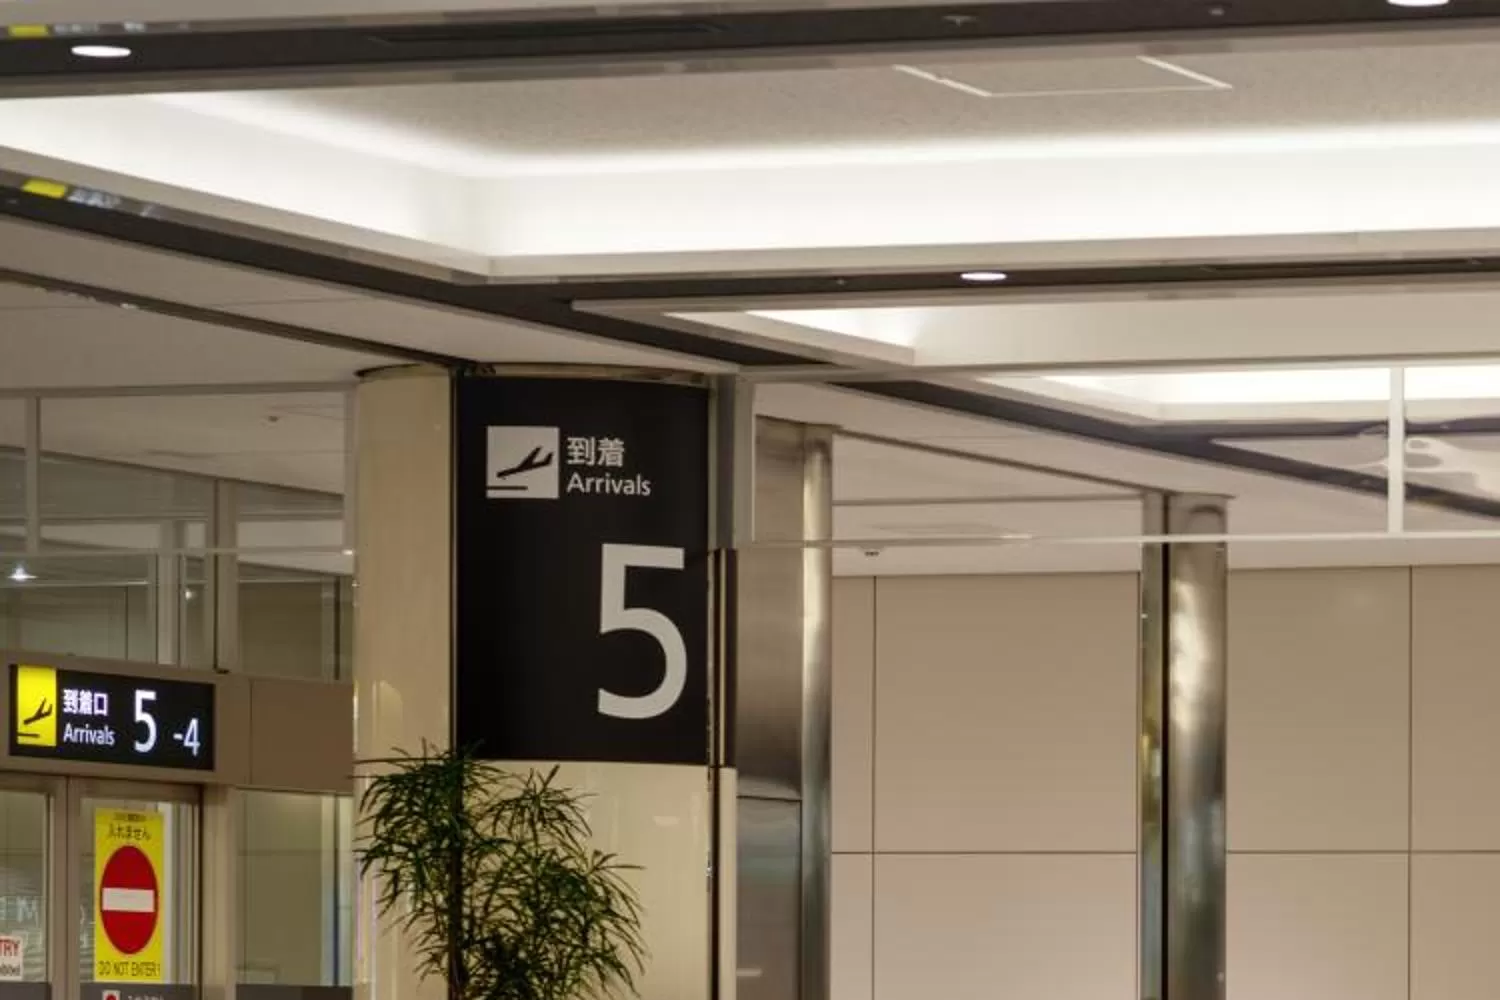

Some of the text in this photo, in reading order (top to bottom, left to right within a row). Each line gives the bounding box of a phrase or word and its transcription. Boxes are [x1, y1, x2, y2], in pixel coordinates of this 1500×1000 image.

[566, 436, 625, 468] 到着
[566, 472, 652, 497] Arrivals
[597, 543, 688, 720] 5
[63, 689, 109, 716] 到着口
[63, 723, 115, 746] Arrivals
[98, 961, 111, 976] DO
[114, 961, 129, 976] NOT
